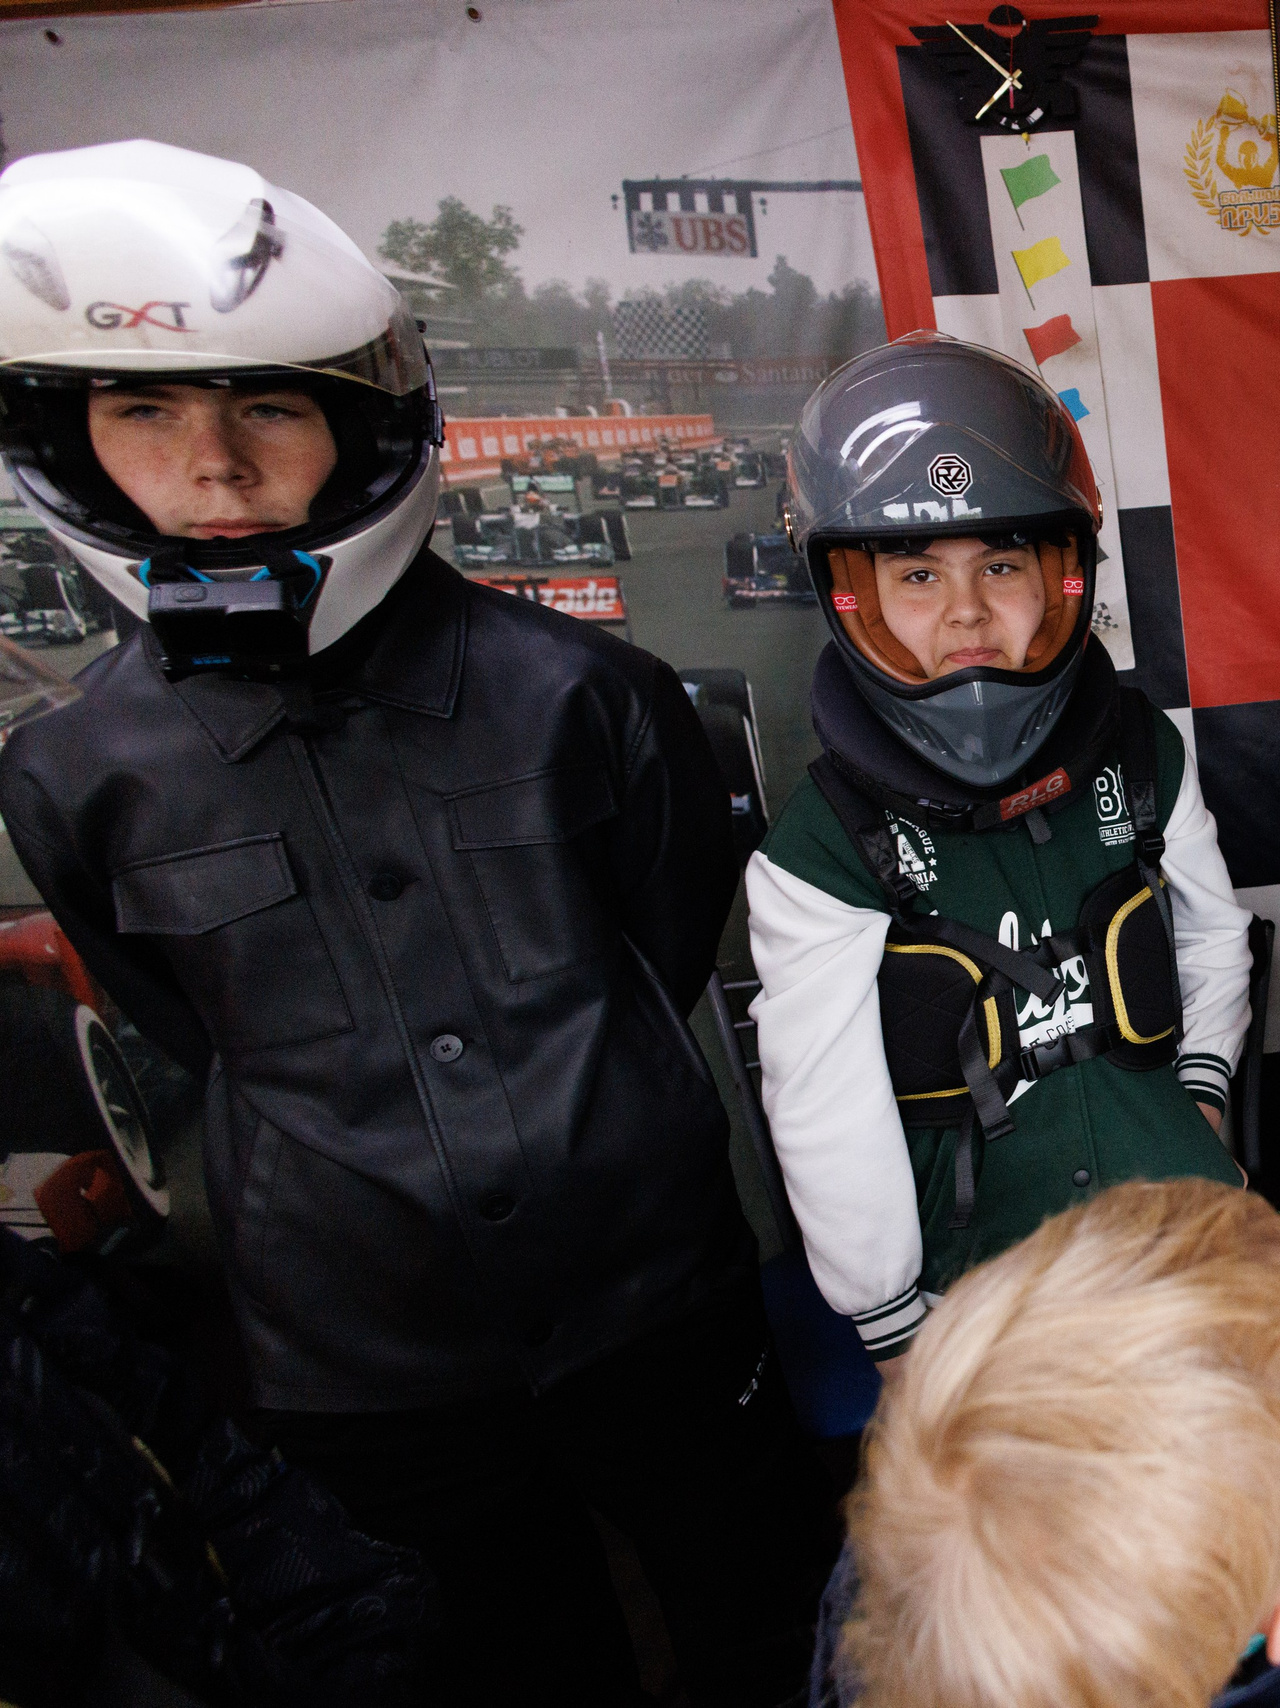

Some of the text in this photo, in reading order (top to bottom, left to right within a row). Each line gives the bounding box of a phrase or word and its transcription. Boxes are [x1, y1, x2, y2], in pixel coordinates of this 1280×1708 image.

[670, 217, 748, 252] UBS
[85, 301, 199, 332] GXT
[1007, 775, 1064, 811] RLG
